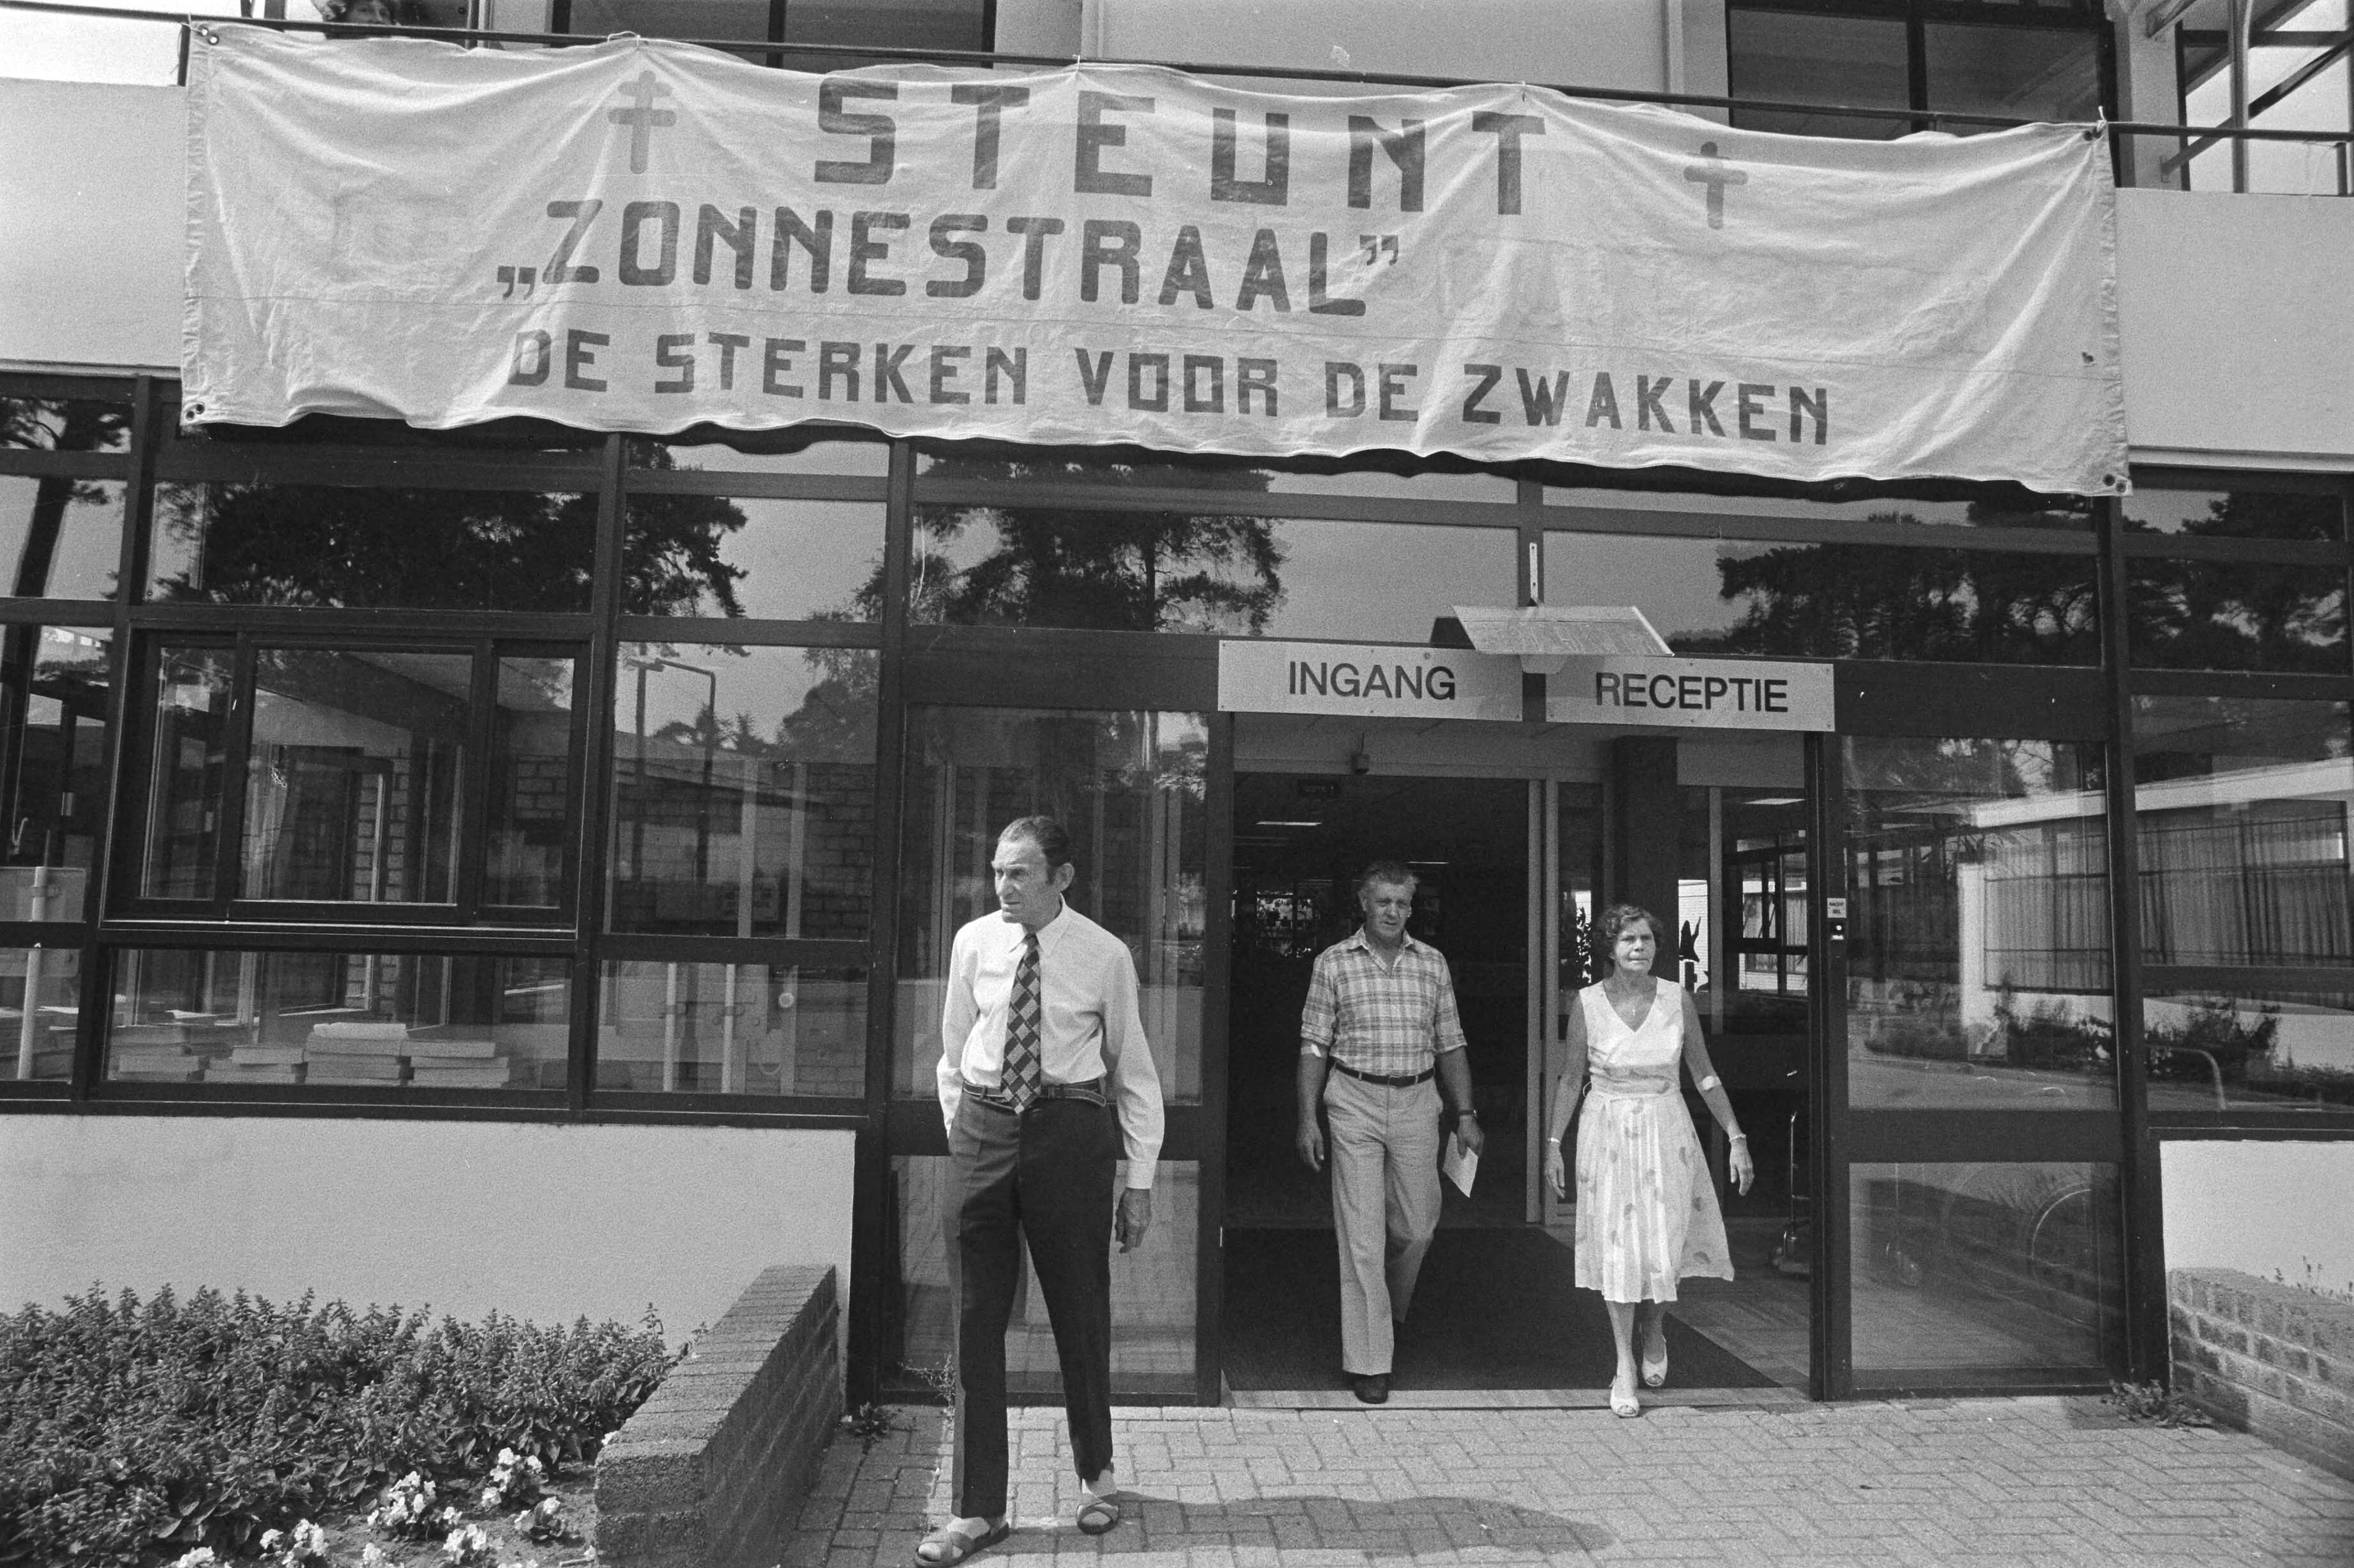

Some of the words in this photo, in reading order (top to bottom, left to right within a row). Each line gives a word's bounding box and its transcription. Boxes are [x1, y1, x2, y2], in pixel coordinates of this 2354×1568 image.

[815, 77, 1546, 215] STEUNT
[508, 329, 610, 392] DE
[654, 331, 1026, 405] STERKEN
[1075, 348, 1278, 417] VOOR
[1325, 362, 1418, 421] DE
[1462, 364, 1827, 445] ZWAKKEN
[1289, 661, 1456, 700] INGANG
[1595, 671, 1788, 713] RECEPTIE
